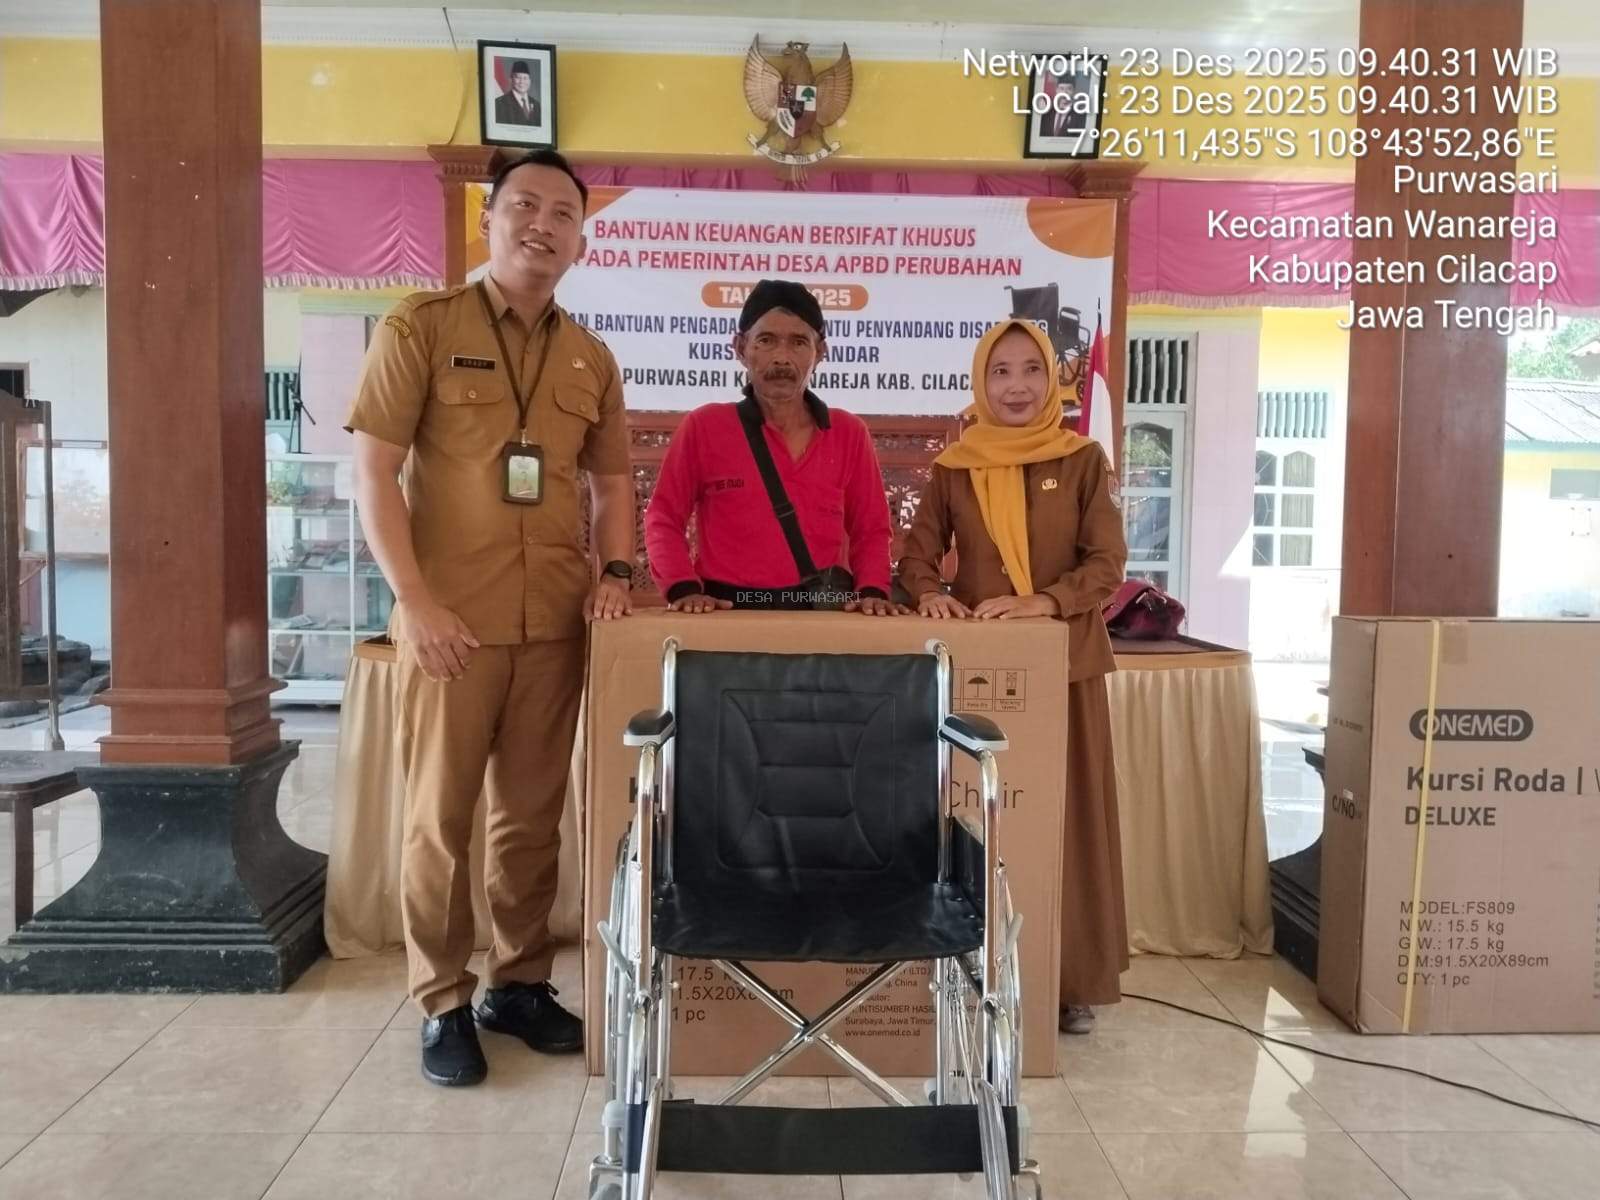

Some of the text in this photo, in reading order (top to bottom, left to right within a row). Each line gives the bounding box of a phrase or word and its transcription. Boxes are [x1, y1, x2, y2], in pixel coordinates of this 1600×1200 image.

[595, 220, 976, 247] BANTUAN KEUANGAN BERSIFAT KHUSUS
[575, 249, 1022, 276] ADA PEMERINTAH DESA APBD PERUBAHAN
[812, 288, 851, 306] 025
[594, 313, 664, 333] BANTUAN
[670, 316, 740, 335] PENGADA
[824, 319, 850, 338] NTU
[856, 320, 954, 339] PENYANDANG
[689, 342, 880, 363] KURS ANDAR
[623, 367, 727, 388] PURWASARI
[811, 372, 870, 389] NAREJA
[877, 373, 915, 390] KAB.
[922, 373, 973, 391] CILAC
[1419, 714, 1525, 737] ONEMED
[1406, 767, 1484, 792] Kursi
[1494, 768, 1566, 792] Roda
[951, 781, 1024, 809] Chir
[1405, 806, 1496, 827] DELUXE
[1487, 919, 1504, 935] kg
[1487, 937, 1504, 953] kg
[1398, 954, 1549, 968] DM:91.5X20X89cm
[678, 966, 714, 981] 17.5
[1452, 975, 1470, 988] pc
[686, 1009, 706, 1024] pc
